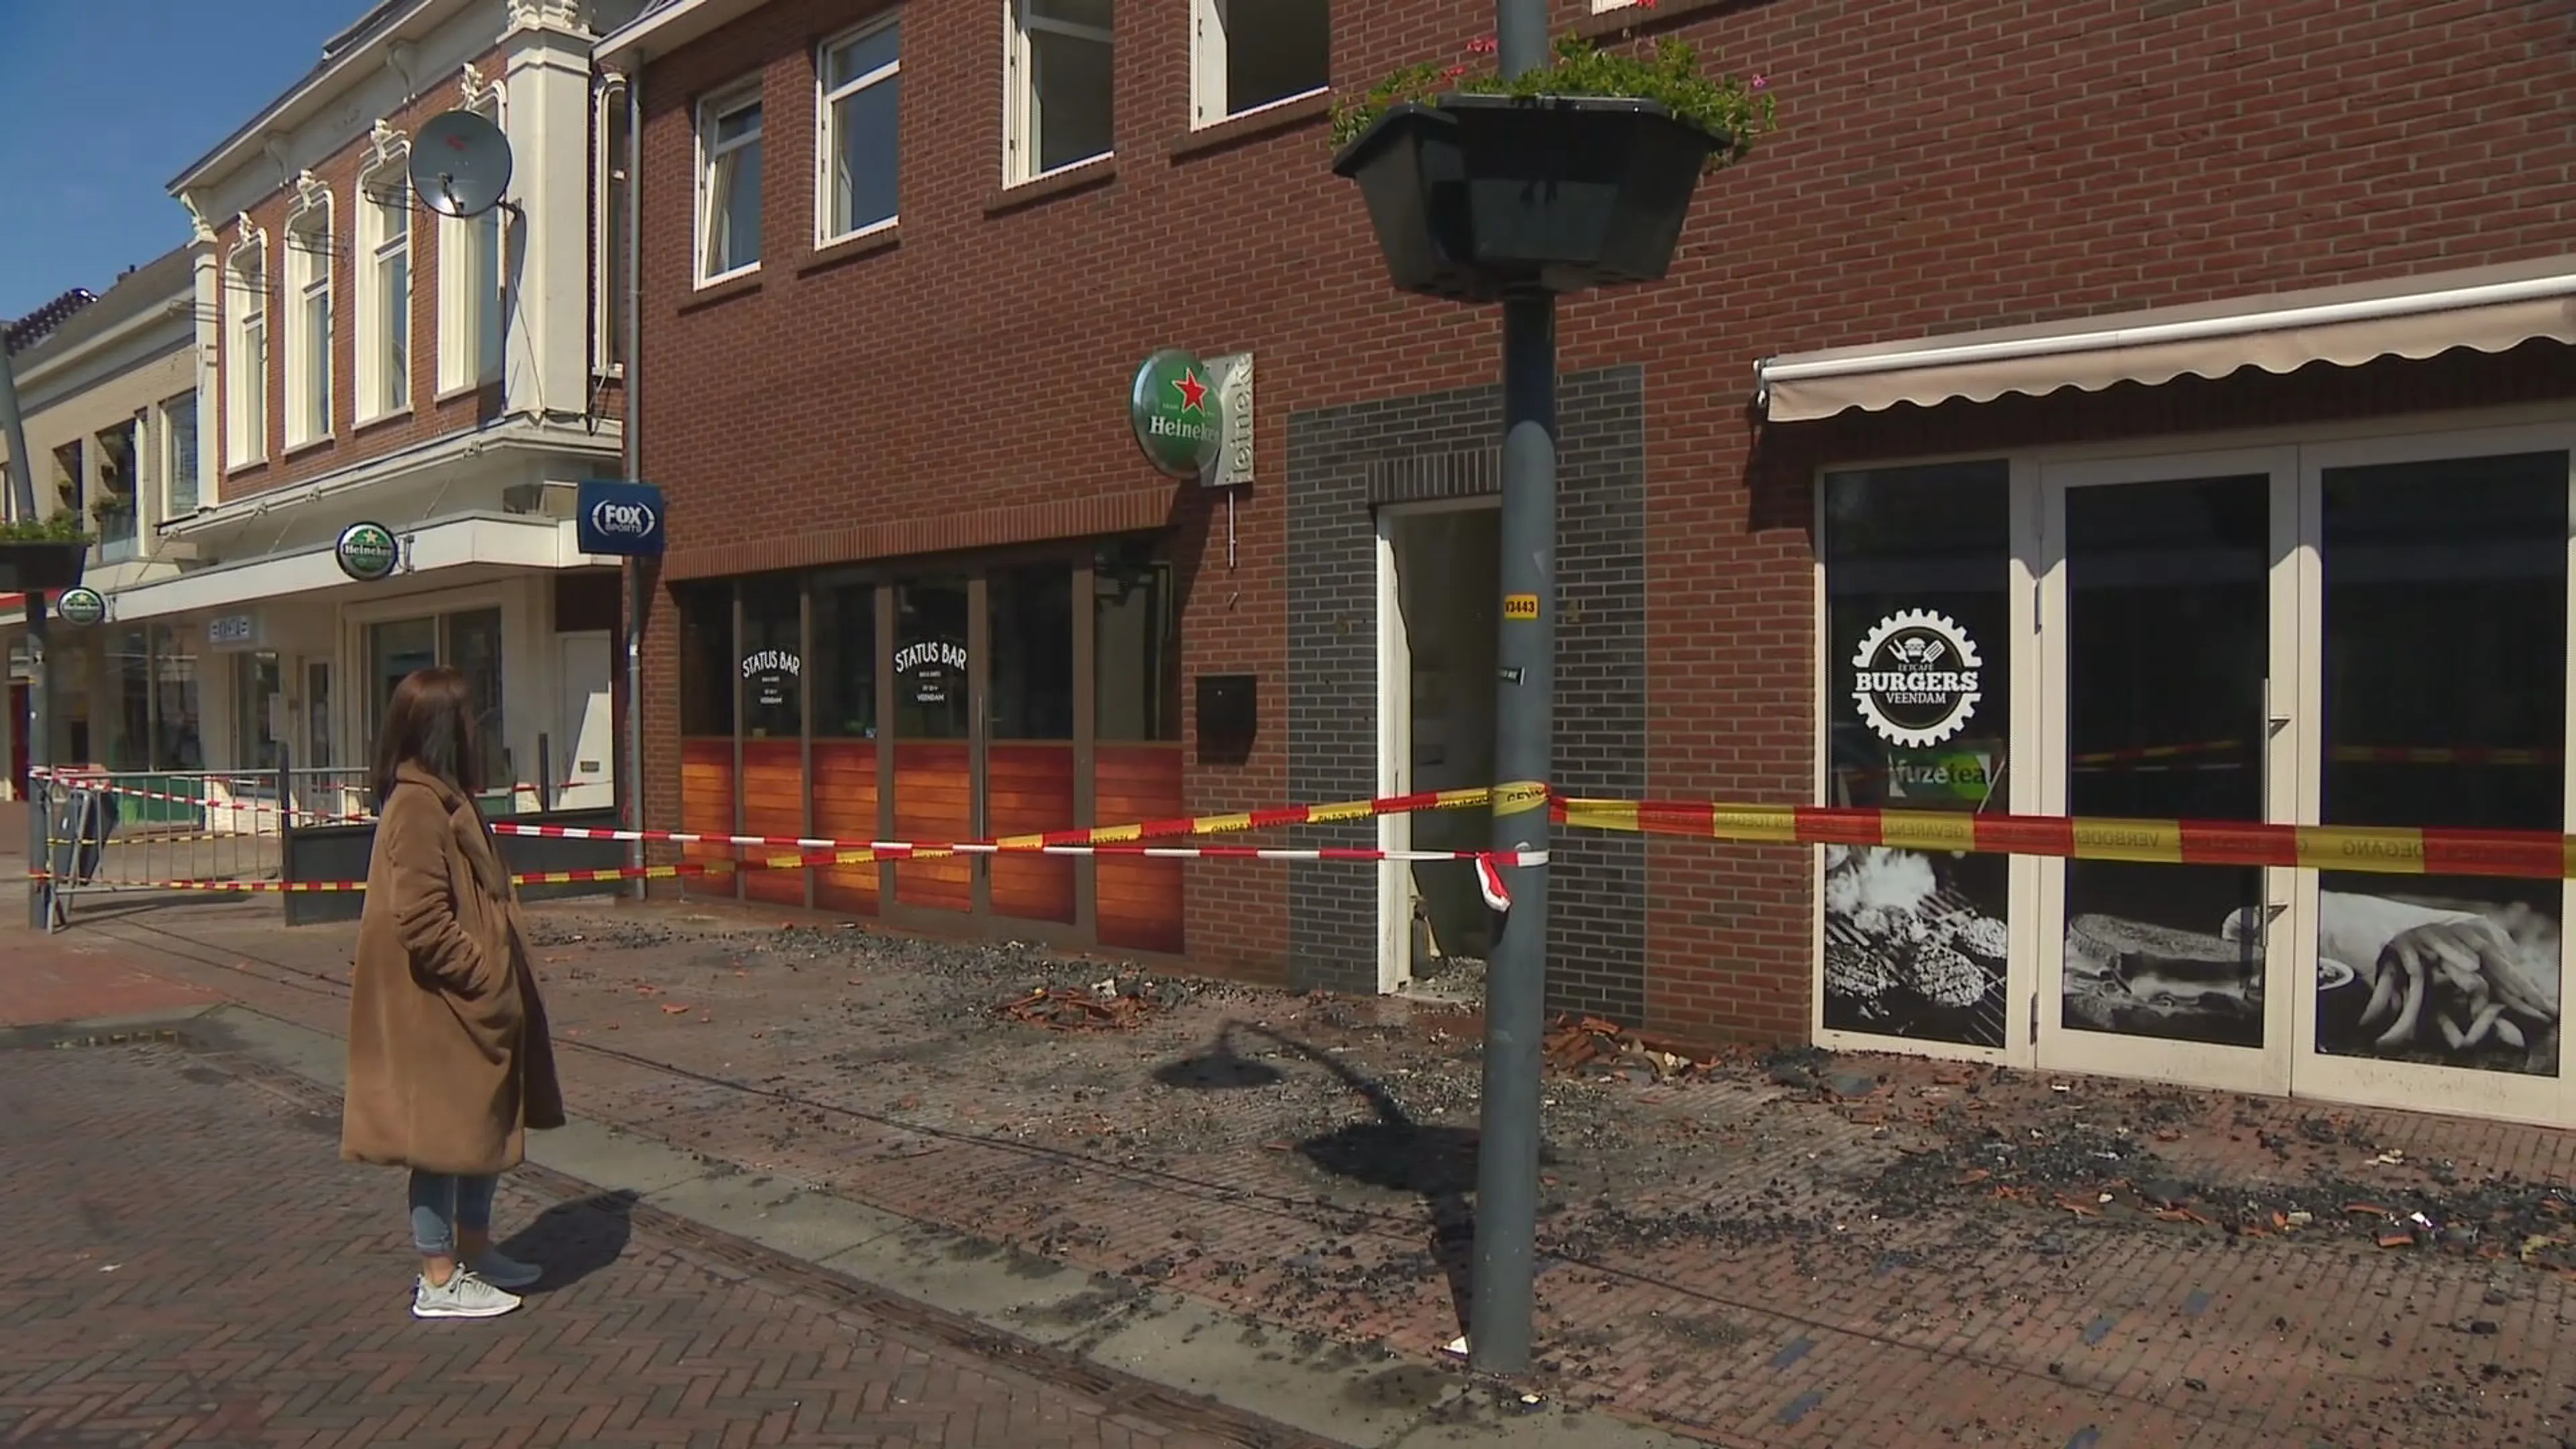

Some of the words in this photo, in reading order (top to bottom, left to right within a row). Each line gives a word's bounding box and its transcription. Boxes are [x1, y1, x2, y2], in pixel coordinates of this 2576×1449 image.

[605, 504, 641, 525] FOX
[742, 650, 777, 678] STATUS
[780, 651, 800, 677] BAR
[895, 641, 938, 673] STATUS
[941, 643, 967, 670] BAR
[1856, 671, 1978, 692] BURGERS
[1885, 692, 1946, 704] VEENDAM
